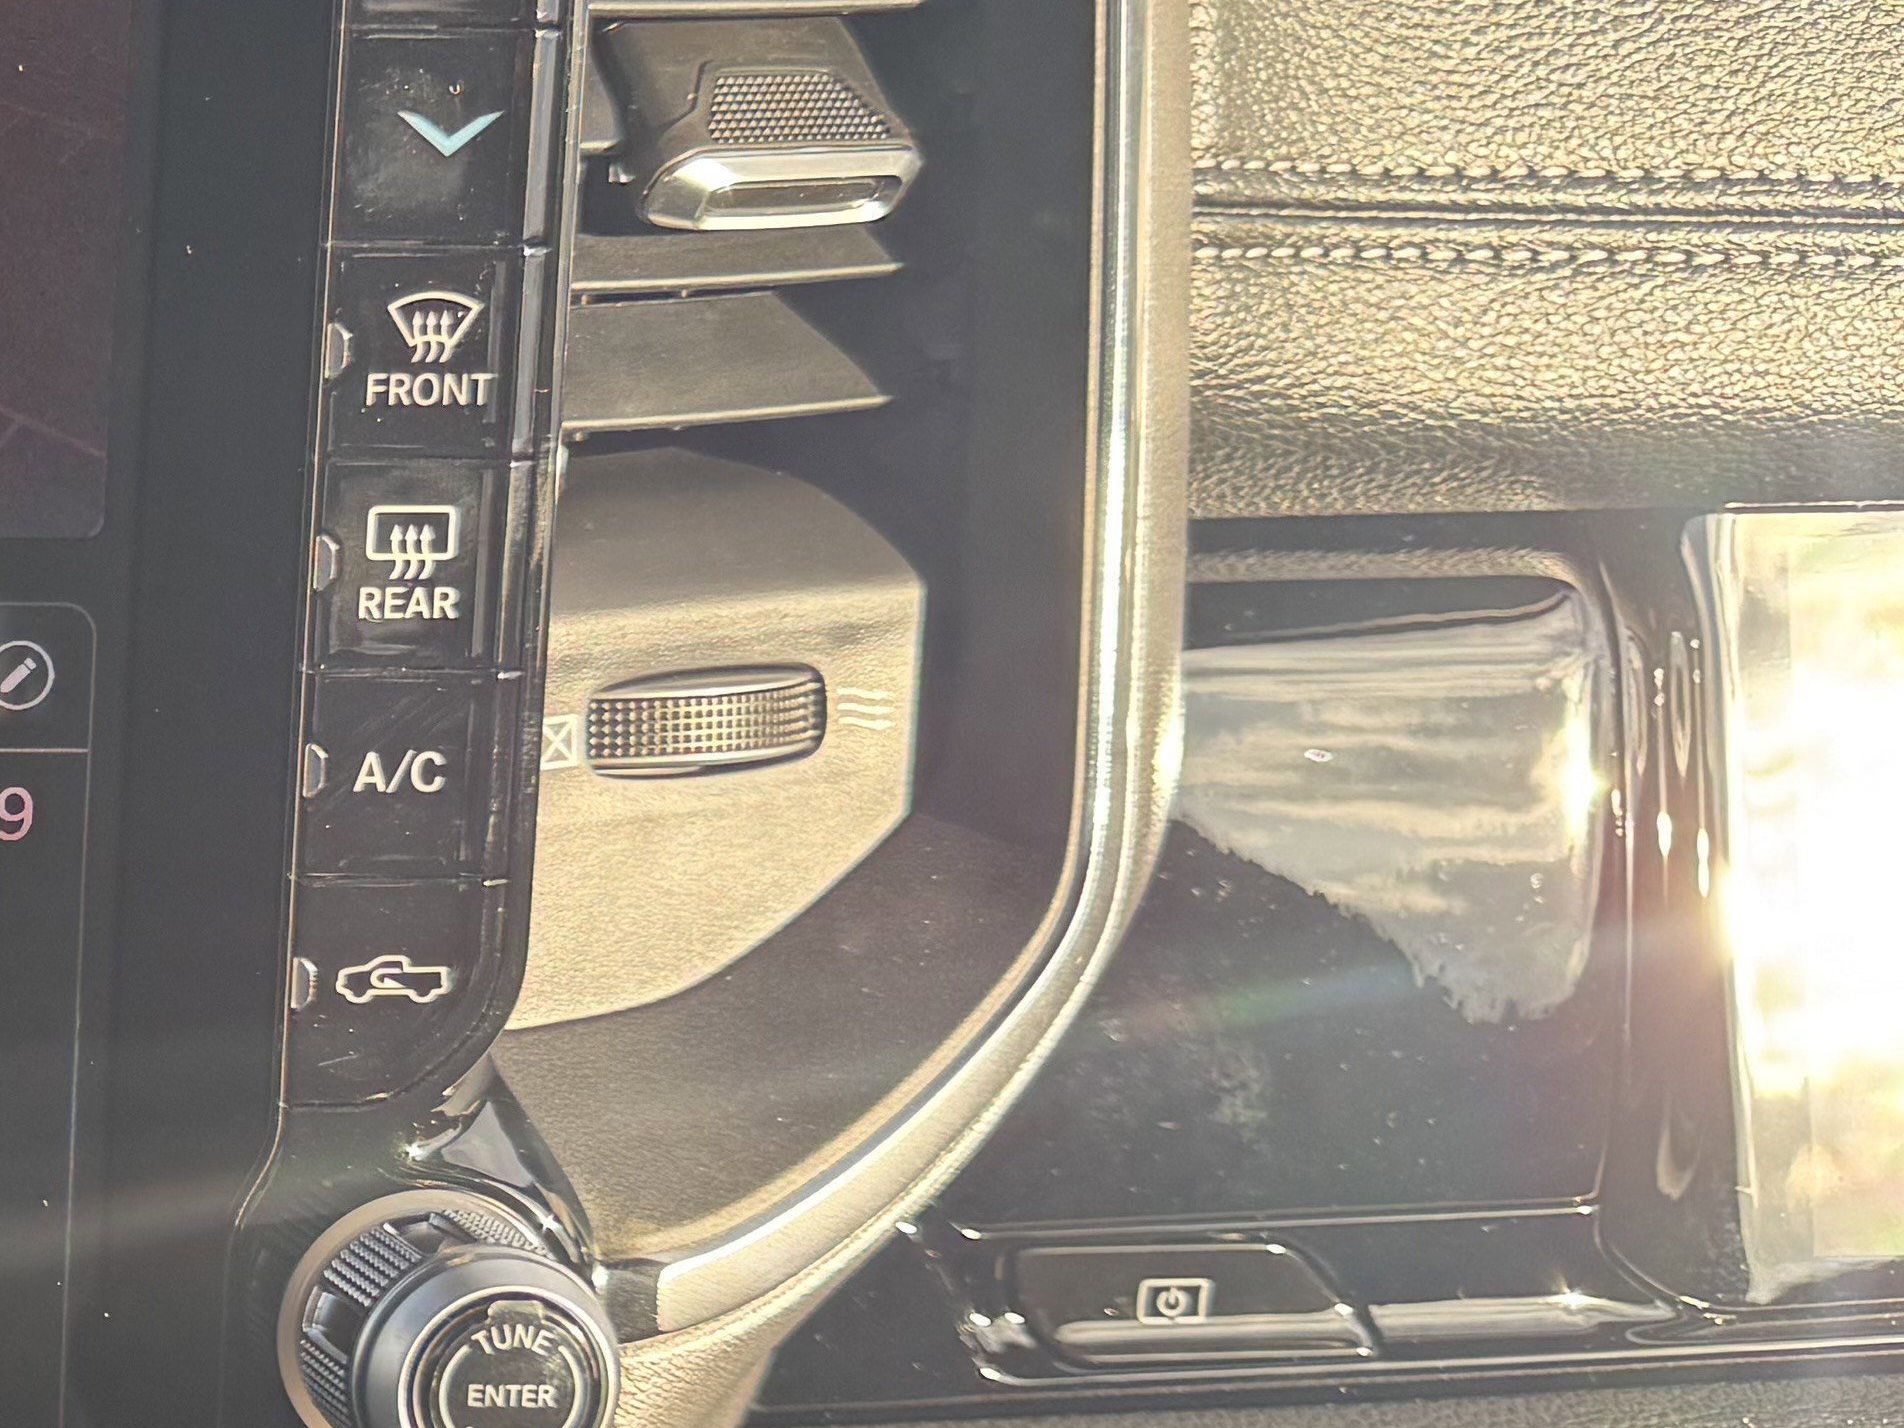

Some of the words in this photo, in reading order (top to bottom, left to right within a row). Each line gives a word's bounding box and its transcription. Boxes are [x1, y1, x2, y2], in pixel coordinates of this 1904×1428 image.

[365, 373, 494, 408] FRONT
[358, 587, 459, 620] REAR
[353, 750, 447, 794] A/C
[472, 1324, 558, 1357] TUNE
[466, 1383, 557, 1409] ENTER
